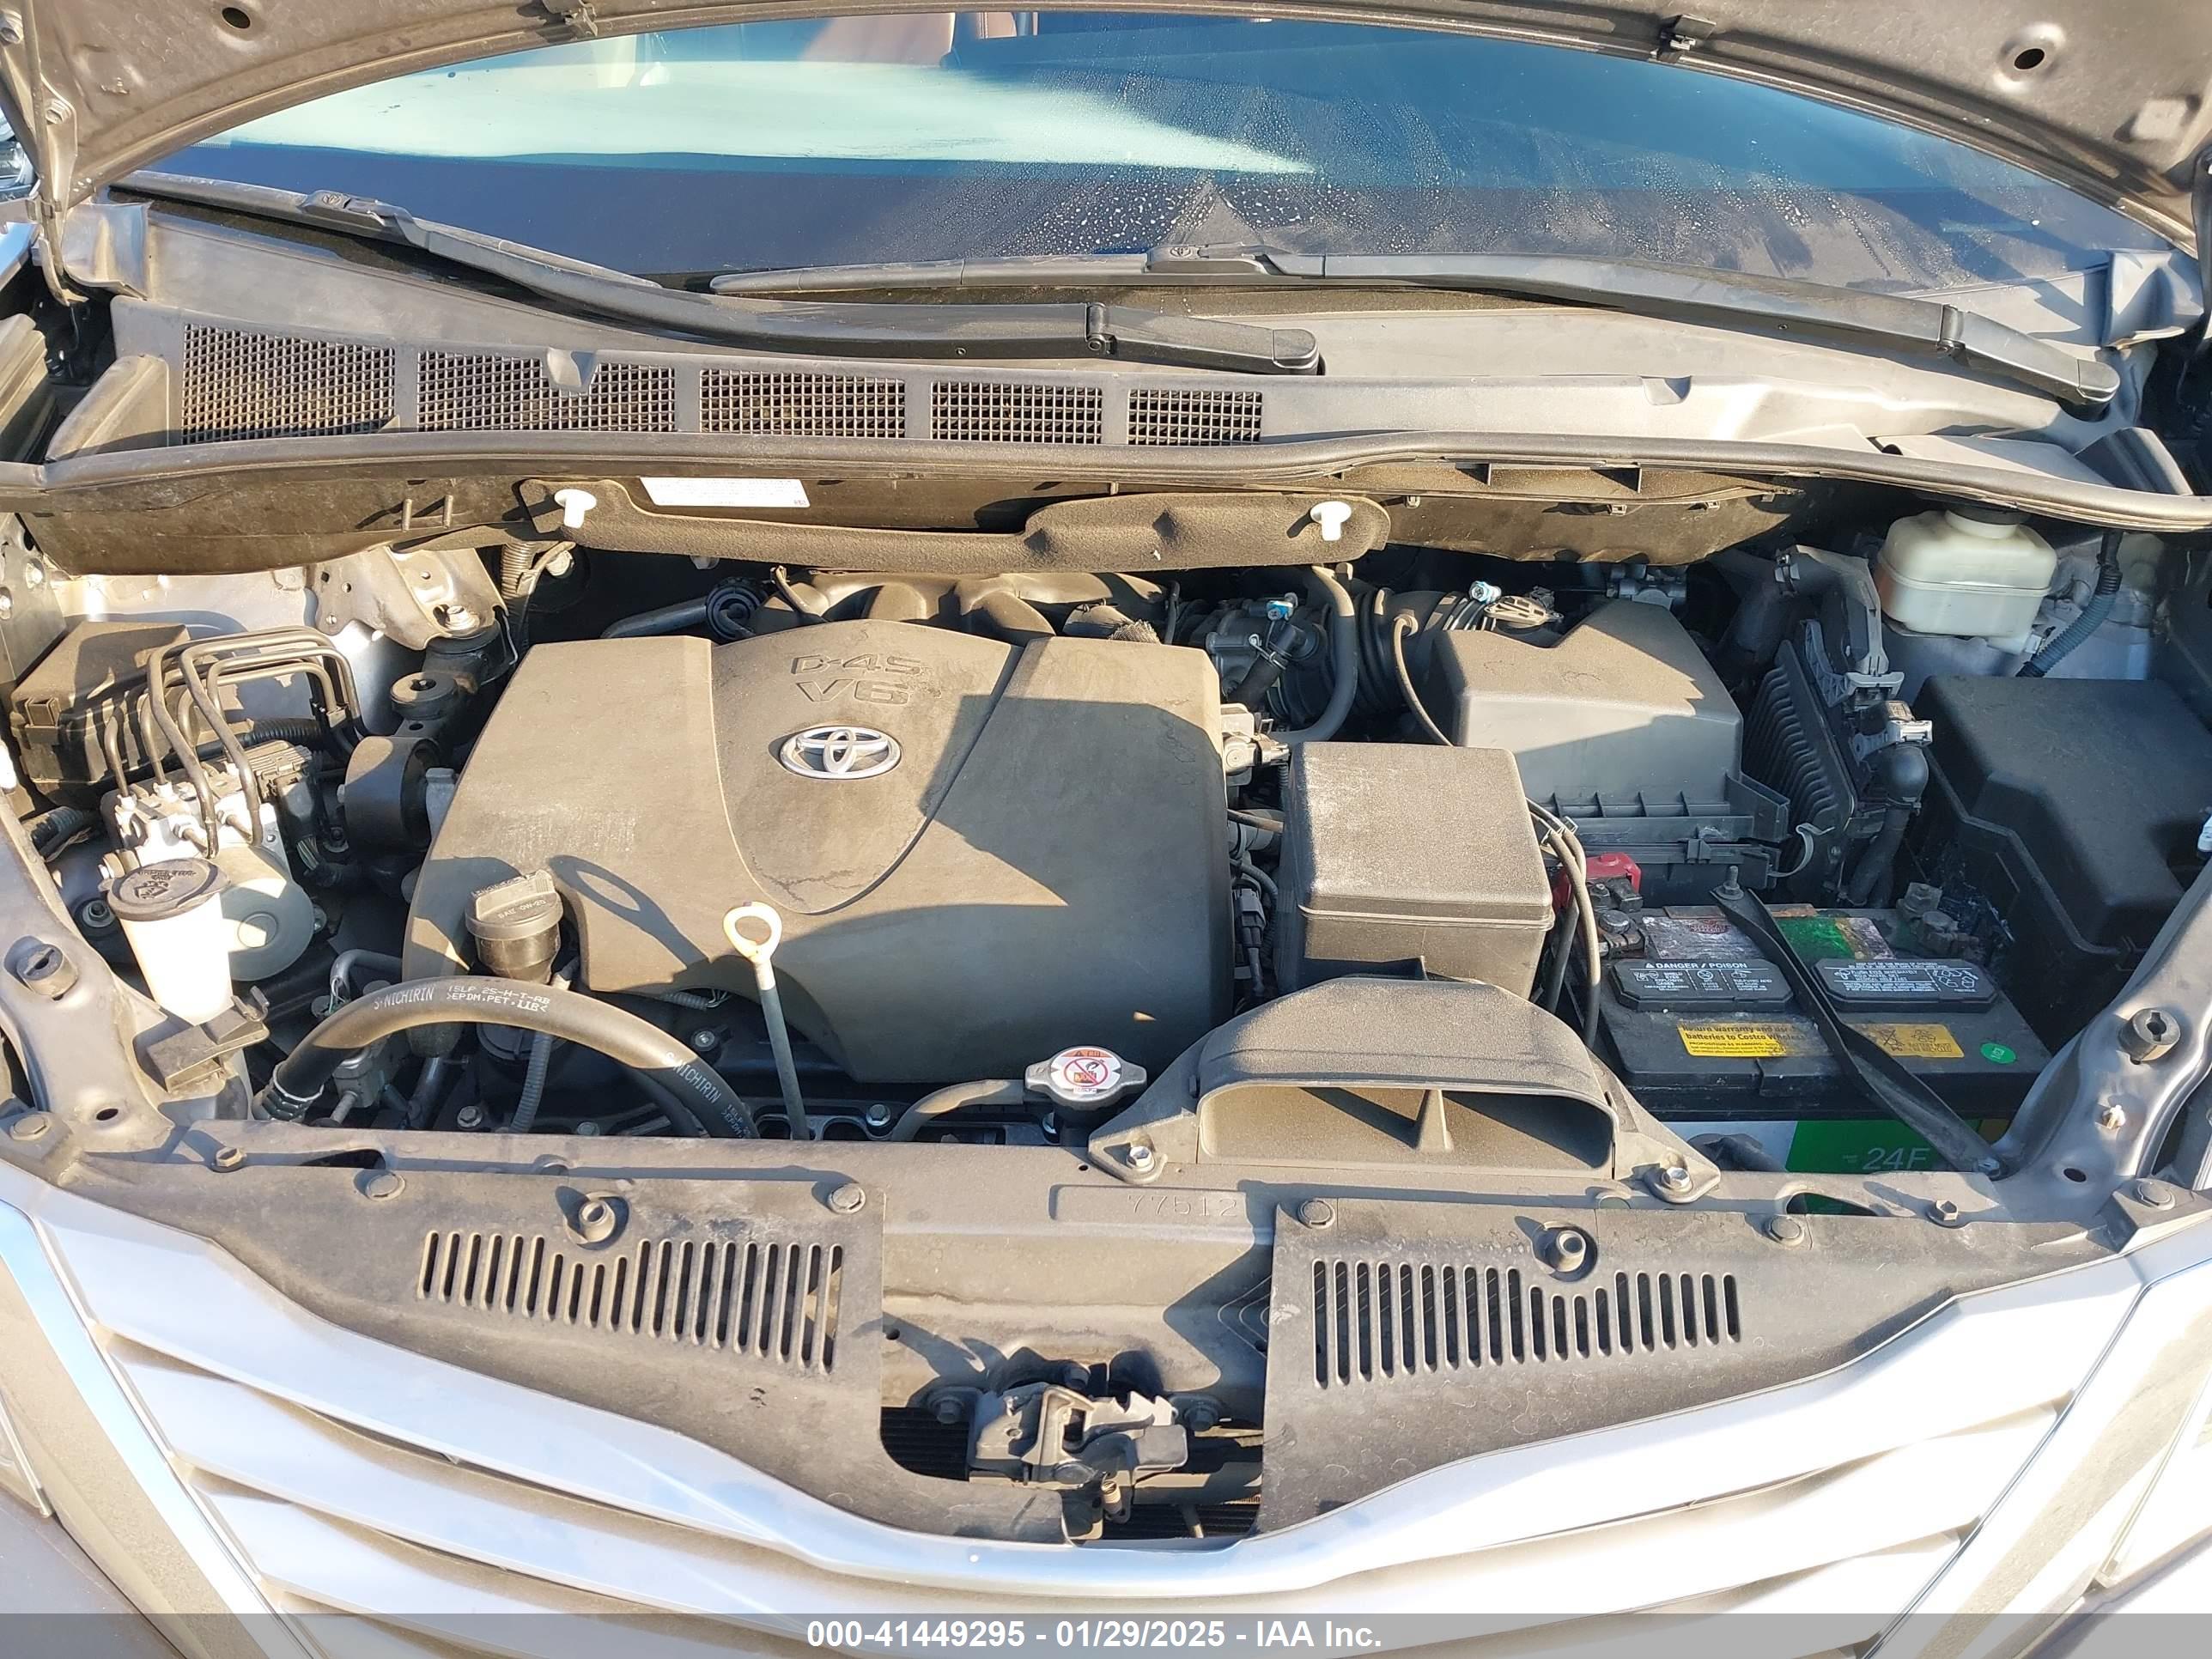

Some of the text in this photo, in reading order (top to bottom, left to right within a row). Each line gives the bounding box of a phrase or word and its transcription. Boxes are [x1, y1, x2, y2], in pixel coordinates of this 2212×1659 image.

[790, 653, 922, 675] D-4S
[795, 678, 910, 706] V6
[1686, 1032, 1726, 1041] batteries
[1861, 1147, 1931, 1170] 24F
[1127, 1194, 1238, 1217] 77512
